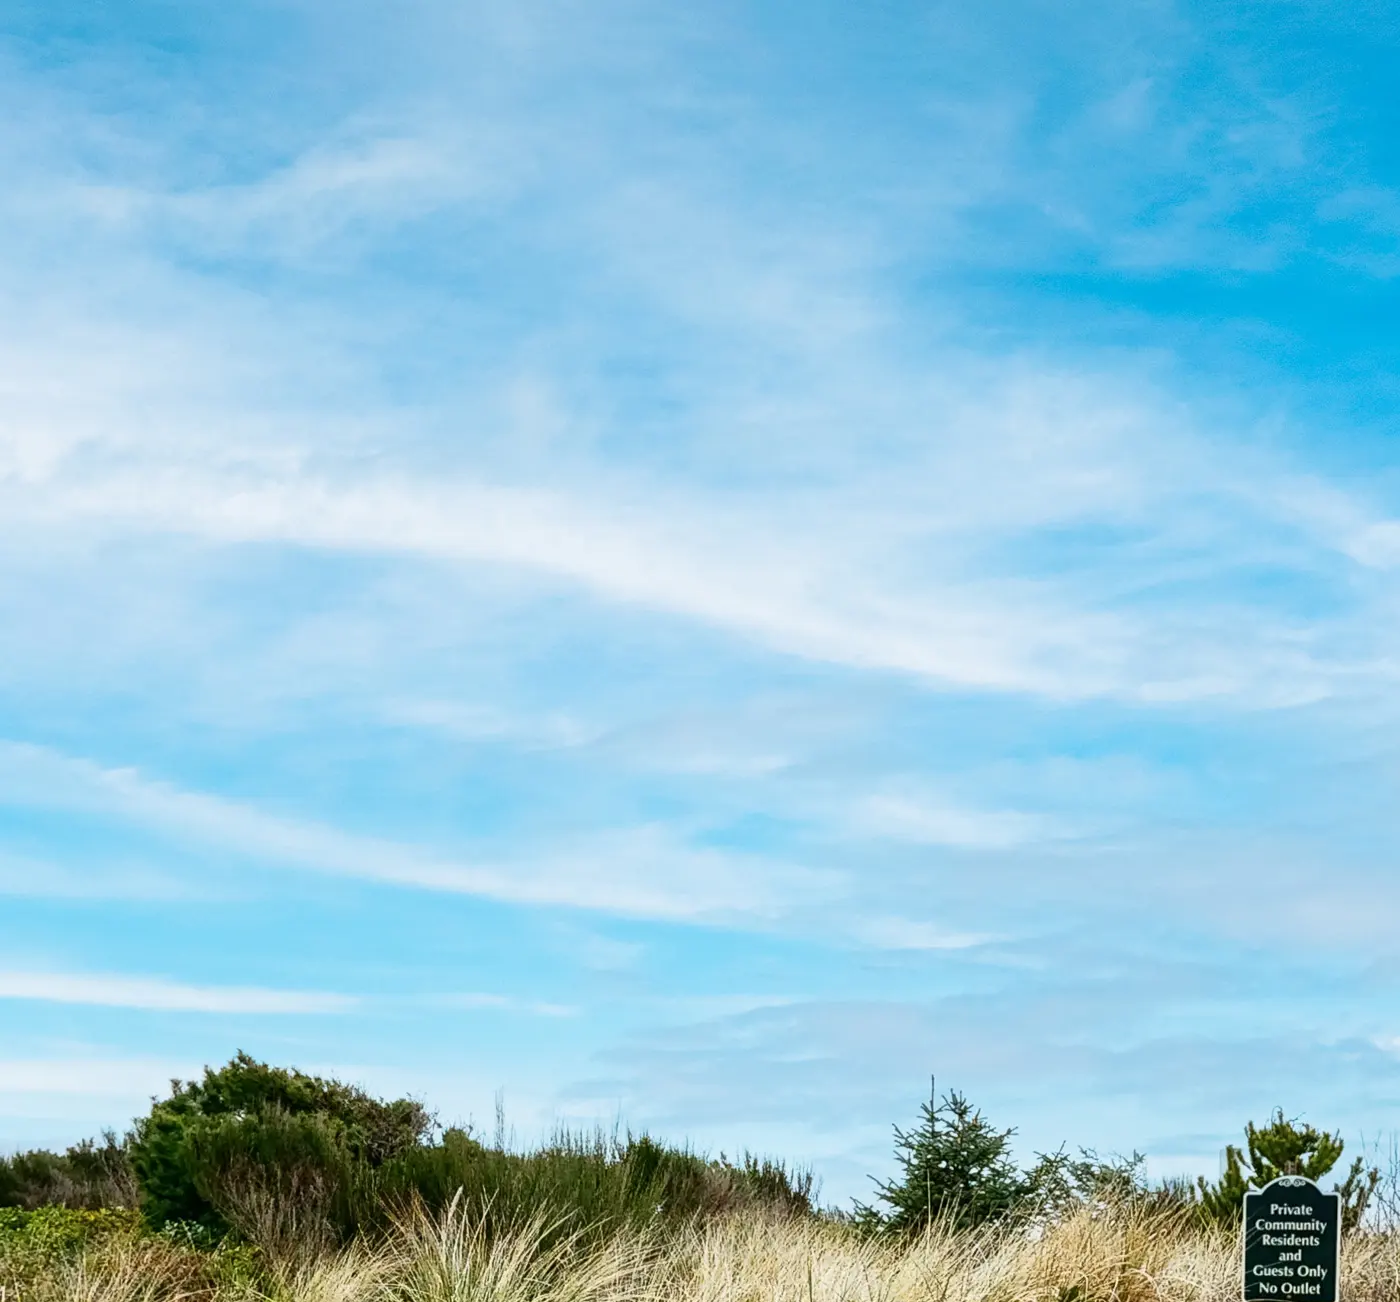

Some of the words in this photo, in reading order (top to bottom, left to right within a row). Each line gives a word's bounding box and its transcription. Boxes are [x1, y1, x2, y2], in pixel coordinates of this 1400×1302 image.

[1270, 1203, 1313, 1215] Private
[1255, 1219, 1327, 1234] Community
[1262, 1234, 1320, 1246] Residents
[1278, 1249, 1302, 1261] and
[1253, 1265, 1294, 1277] Guests
[1297, 1265, 1328, 1280] Only
[1259, 1282, 1278, 1294] No
[1281, 1282, 1321, 1294] Outlet
